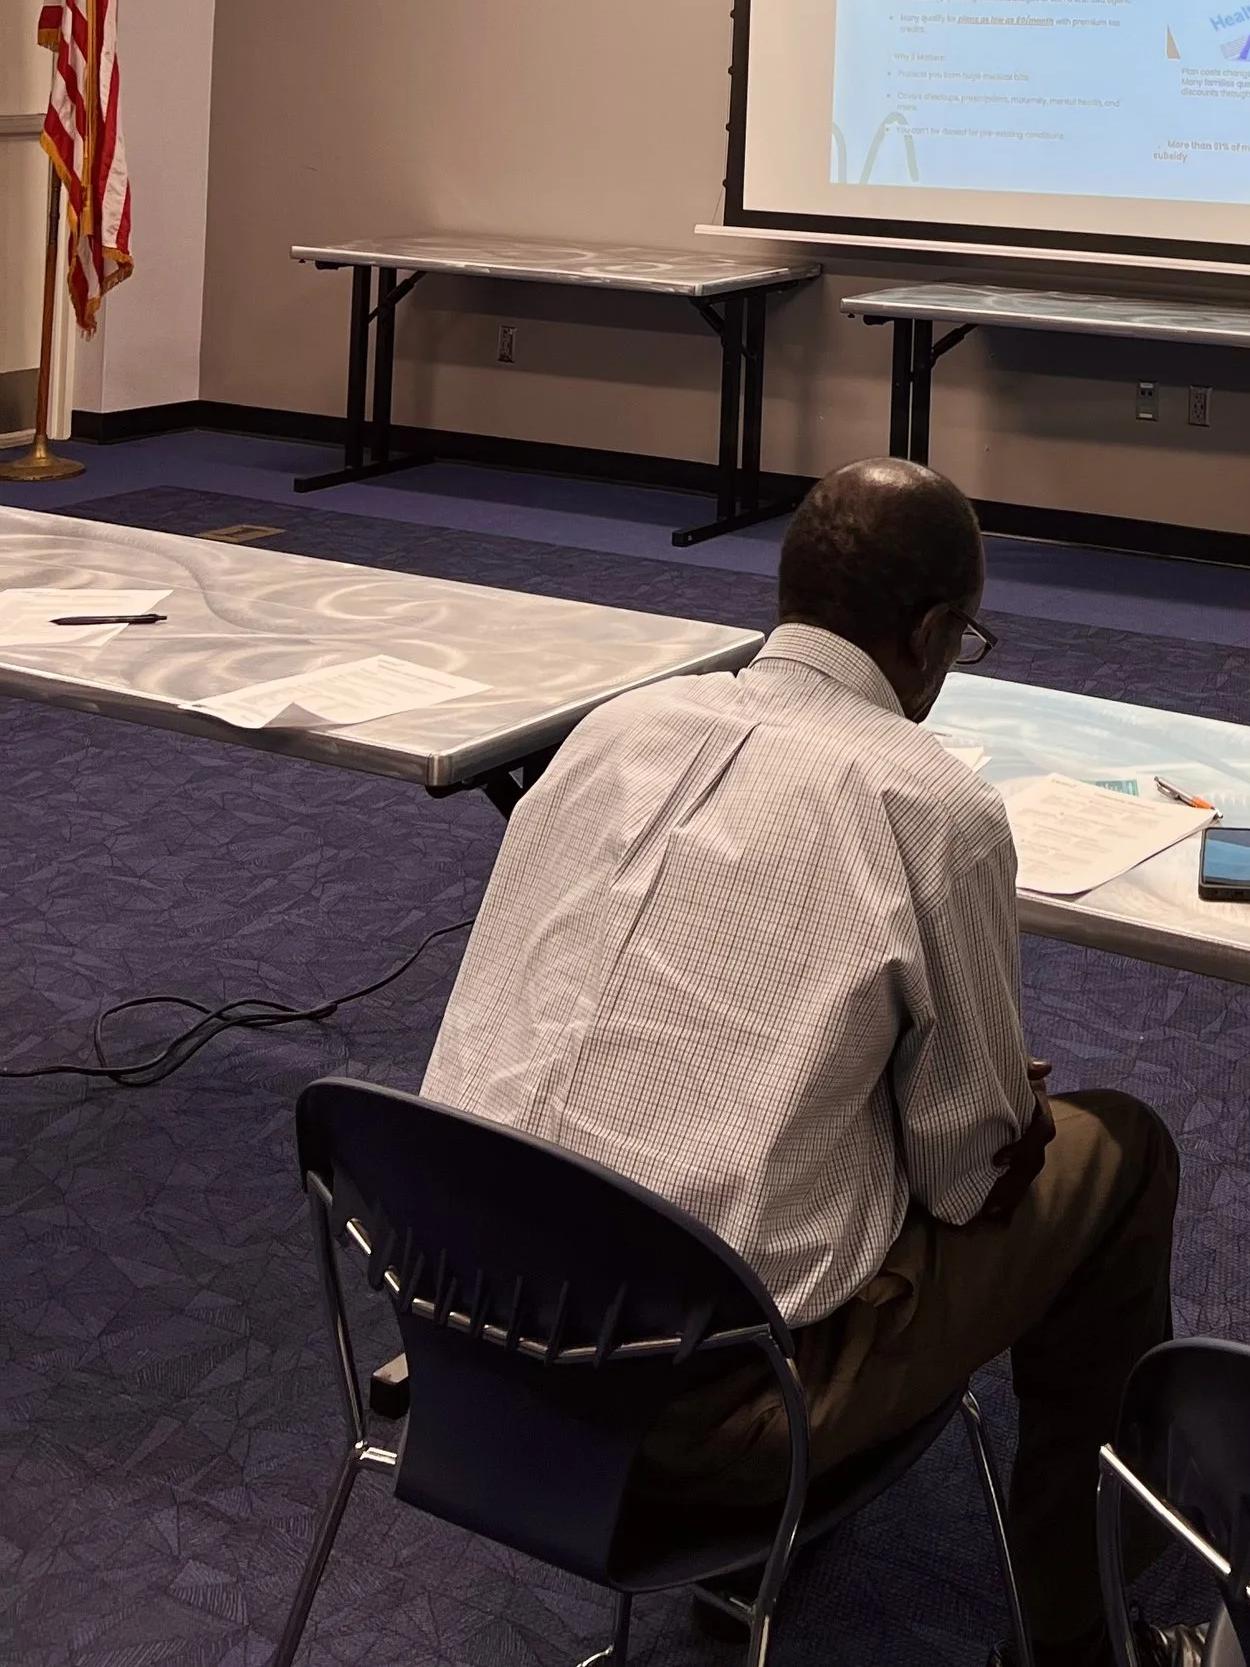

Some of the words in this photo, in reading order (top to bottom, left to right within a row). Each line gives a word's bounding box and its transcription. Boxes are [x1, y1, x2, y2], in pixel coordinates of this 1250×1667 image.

[1167, 139, 1190, 150] More
[1190, 140, 1213, 150] than
[1231, 142, 1241, 152] of
[1153, 151, 1188, 165] subsidy
